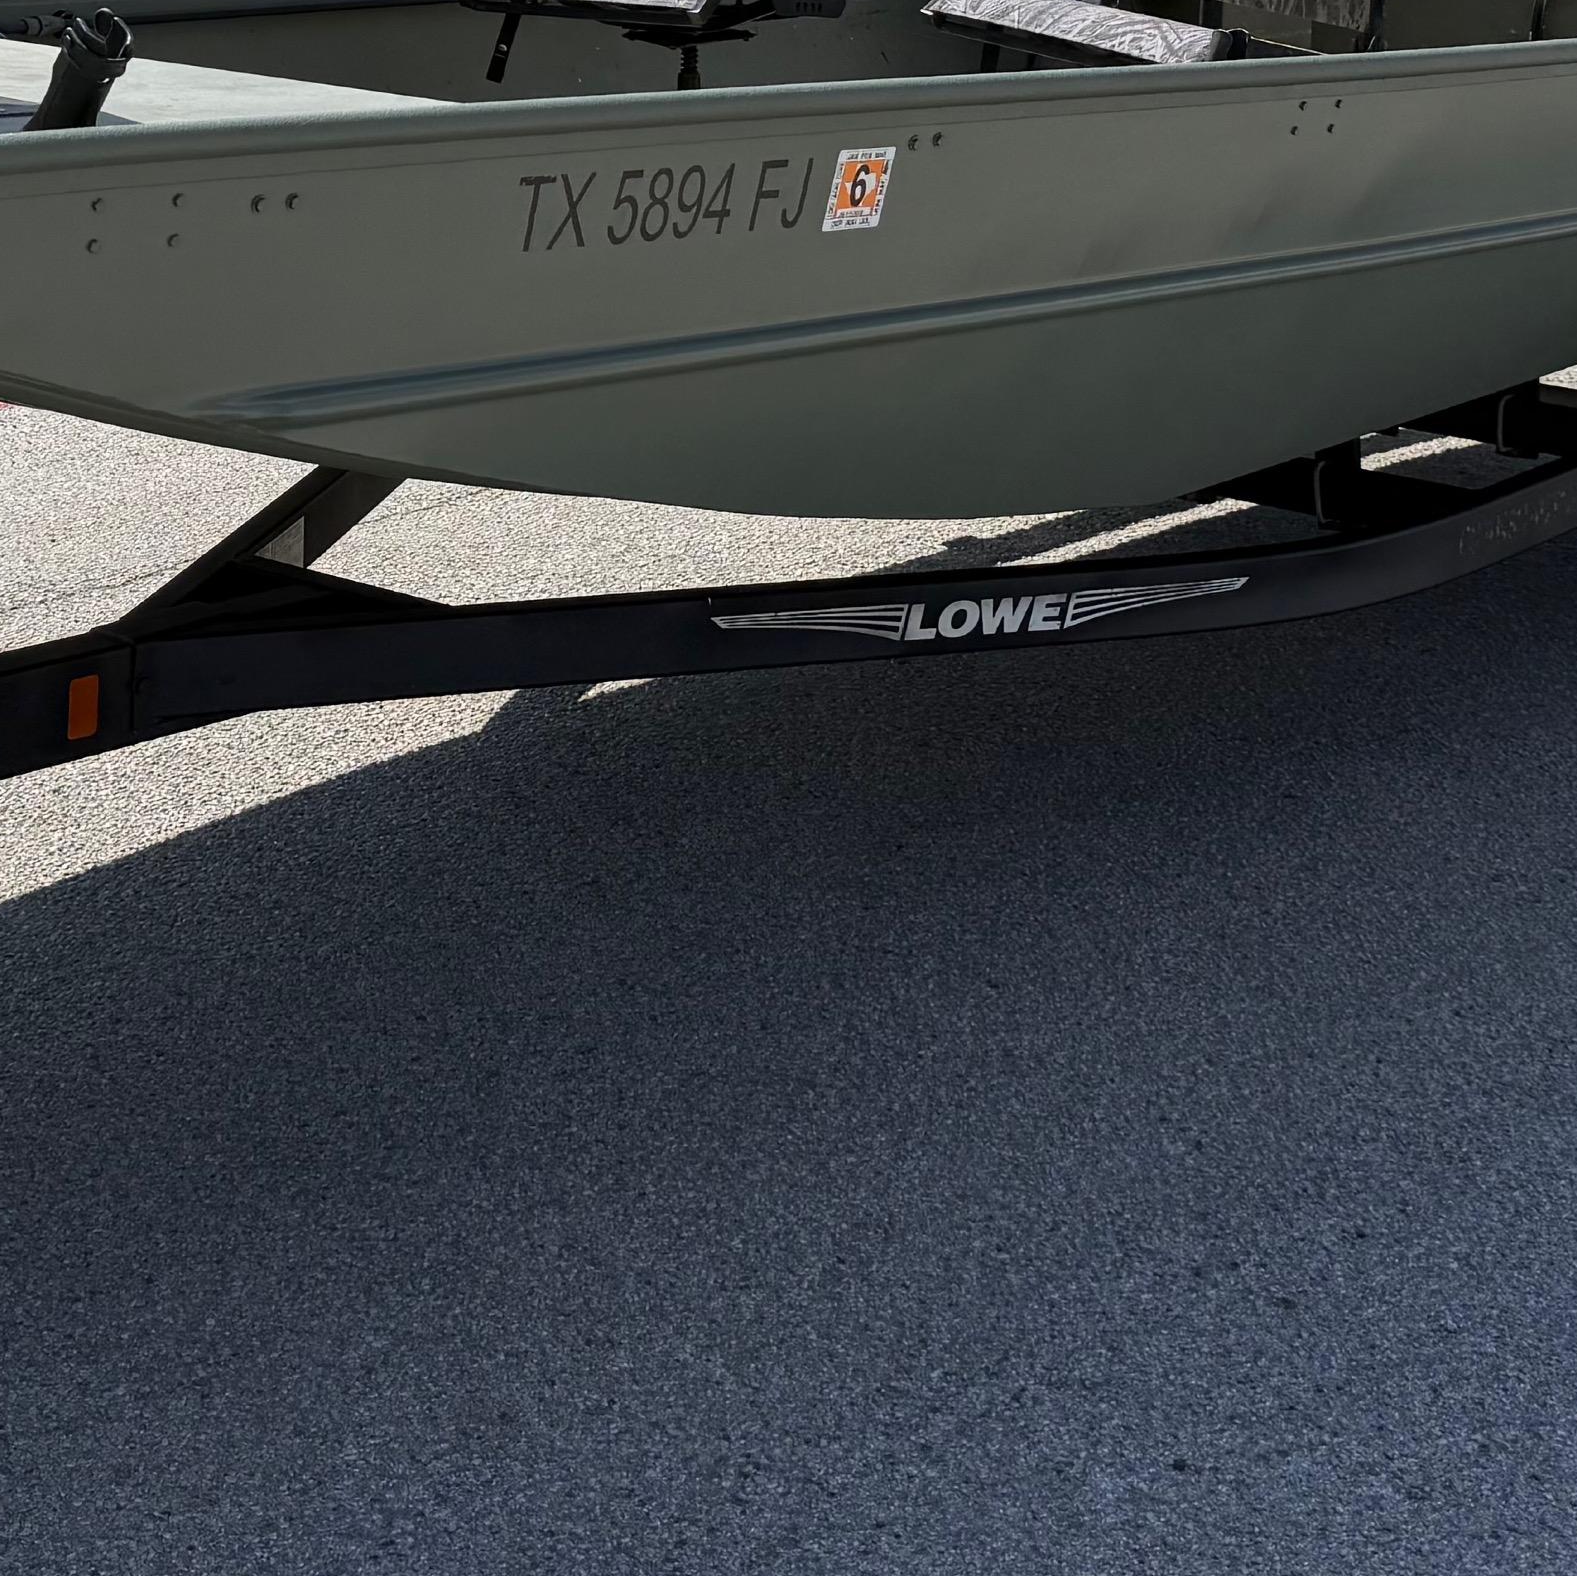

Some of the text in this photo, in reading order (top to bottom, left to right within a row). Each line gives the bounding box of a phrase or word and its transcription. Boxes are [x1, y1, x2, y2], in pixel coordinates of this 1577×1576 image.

[519, 172, 597, 252] TX
[607, 163, 736, 246] 5894
[749, 158, 814, 232] FJ
[849, 164, 870, 207] 6
[903, 592, 1067, 641] LOWE
